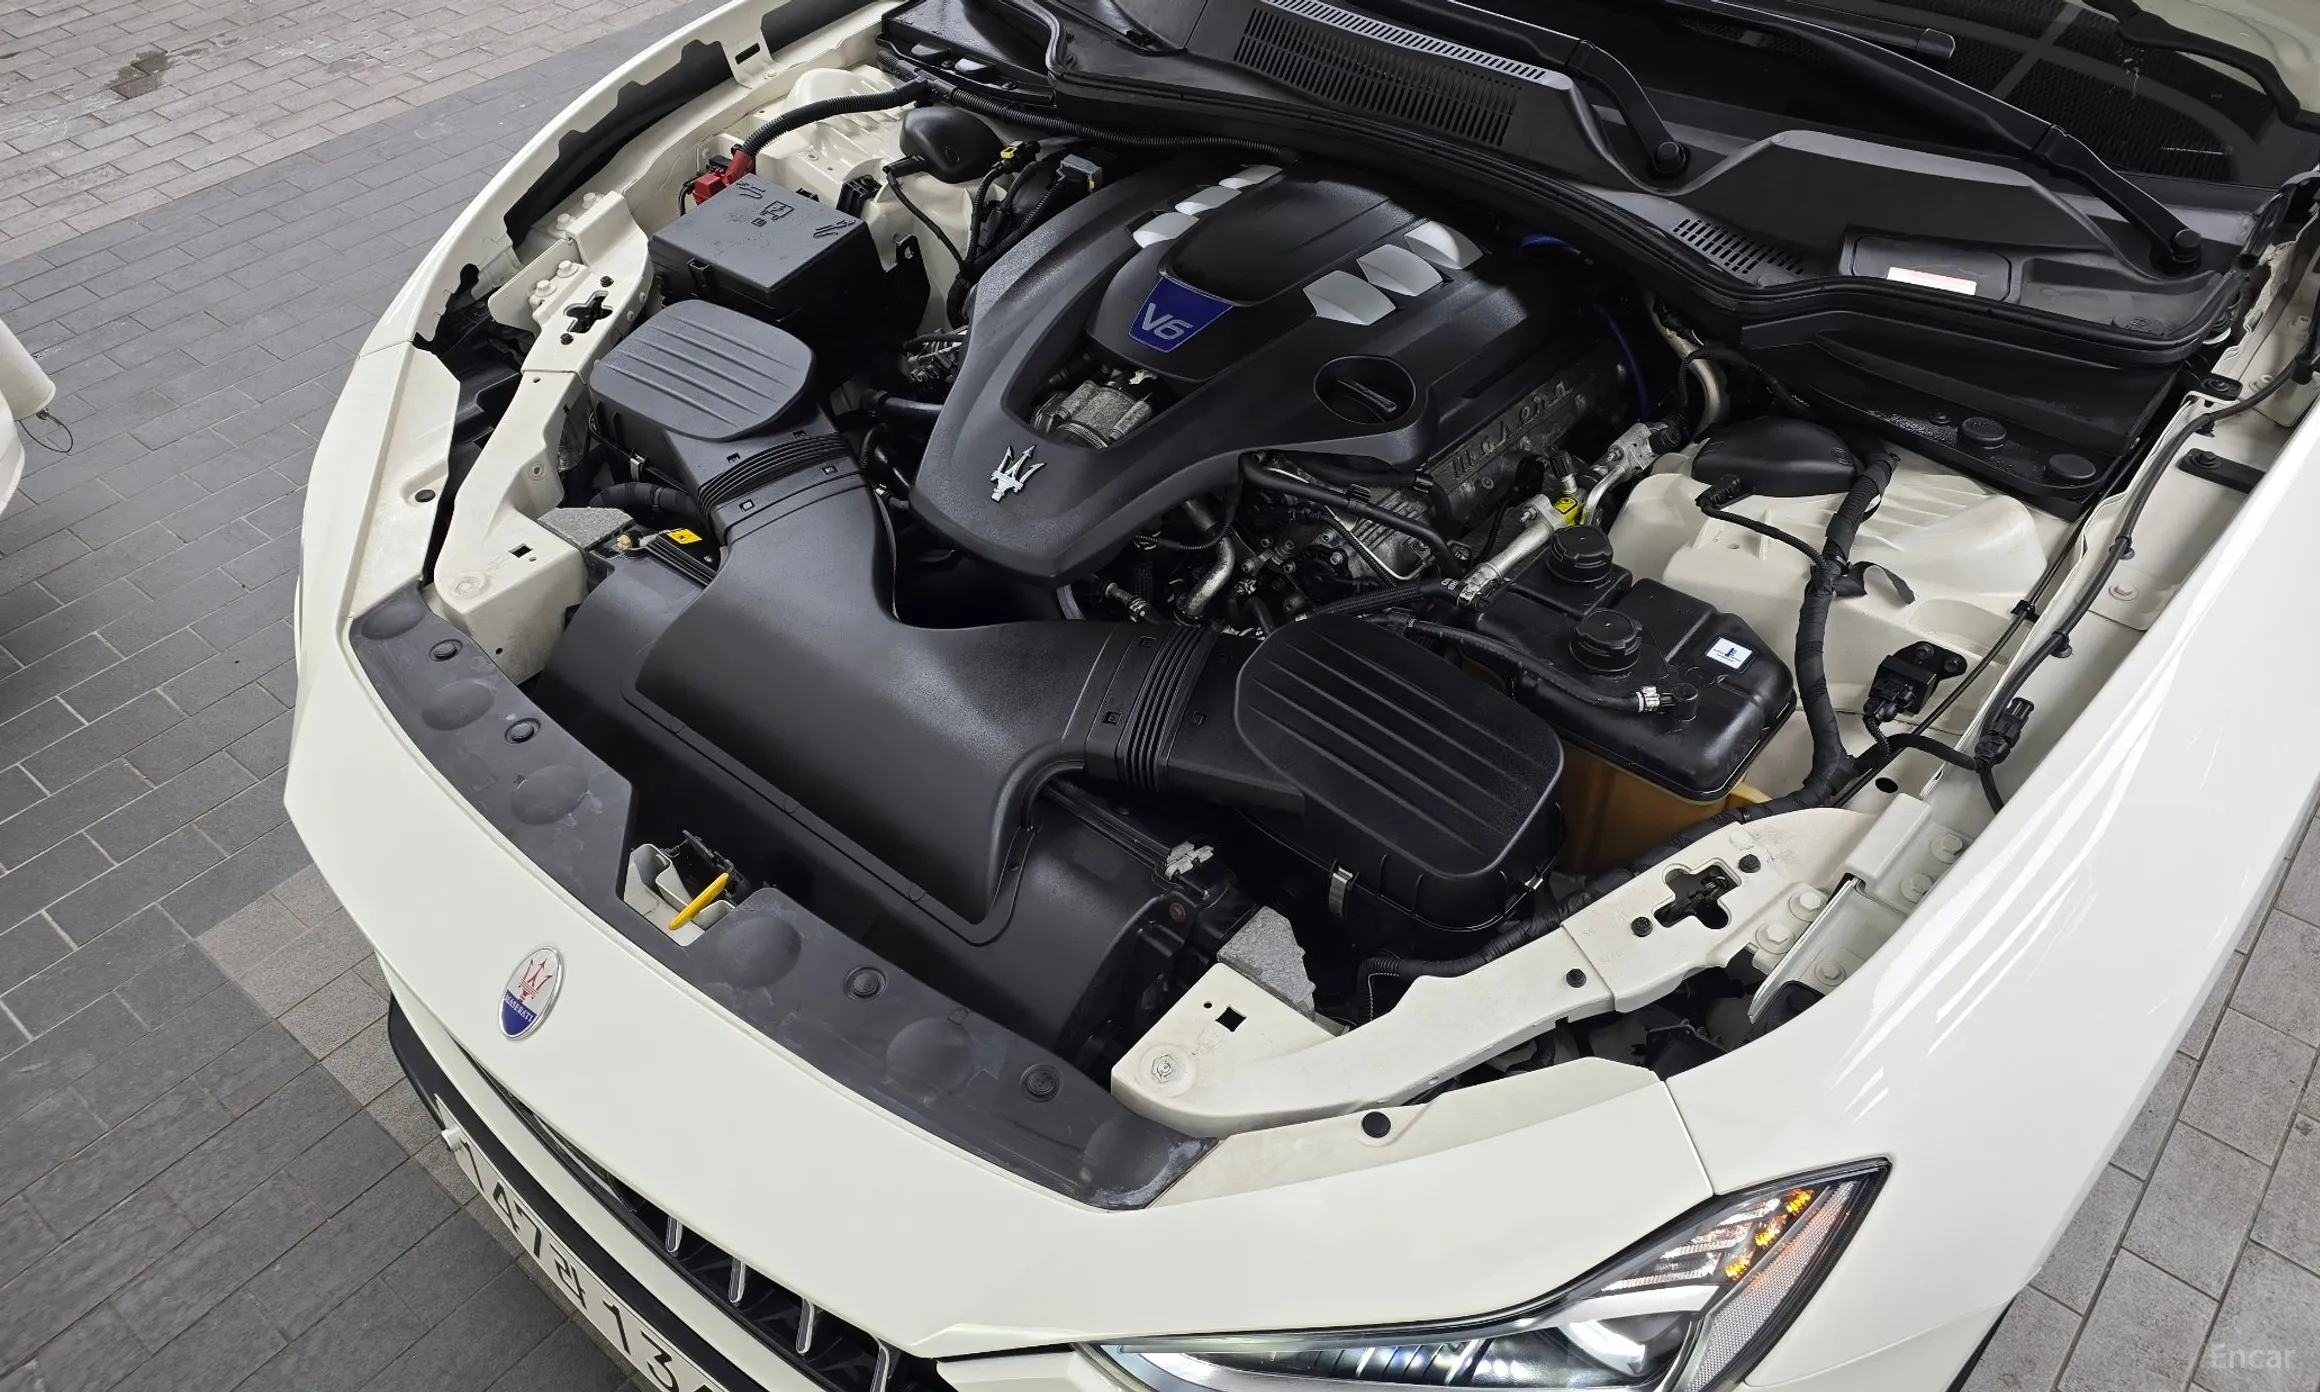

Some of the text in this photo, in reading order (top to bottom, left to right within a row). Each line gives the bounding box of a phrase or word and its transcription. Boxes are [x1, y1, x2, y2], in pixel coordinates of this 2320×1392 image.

[1141, 302, 1194, 340] V6
[506, 994, 534, 1023] MASERATI
[459, 1136, 713, 1392] 147라 13
